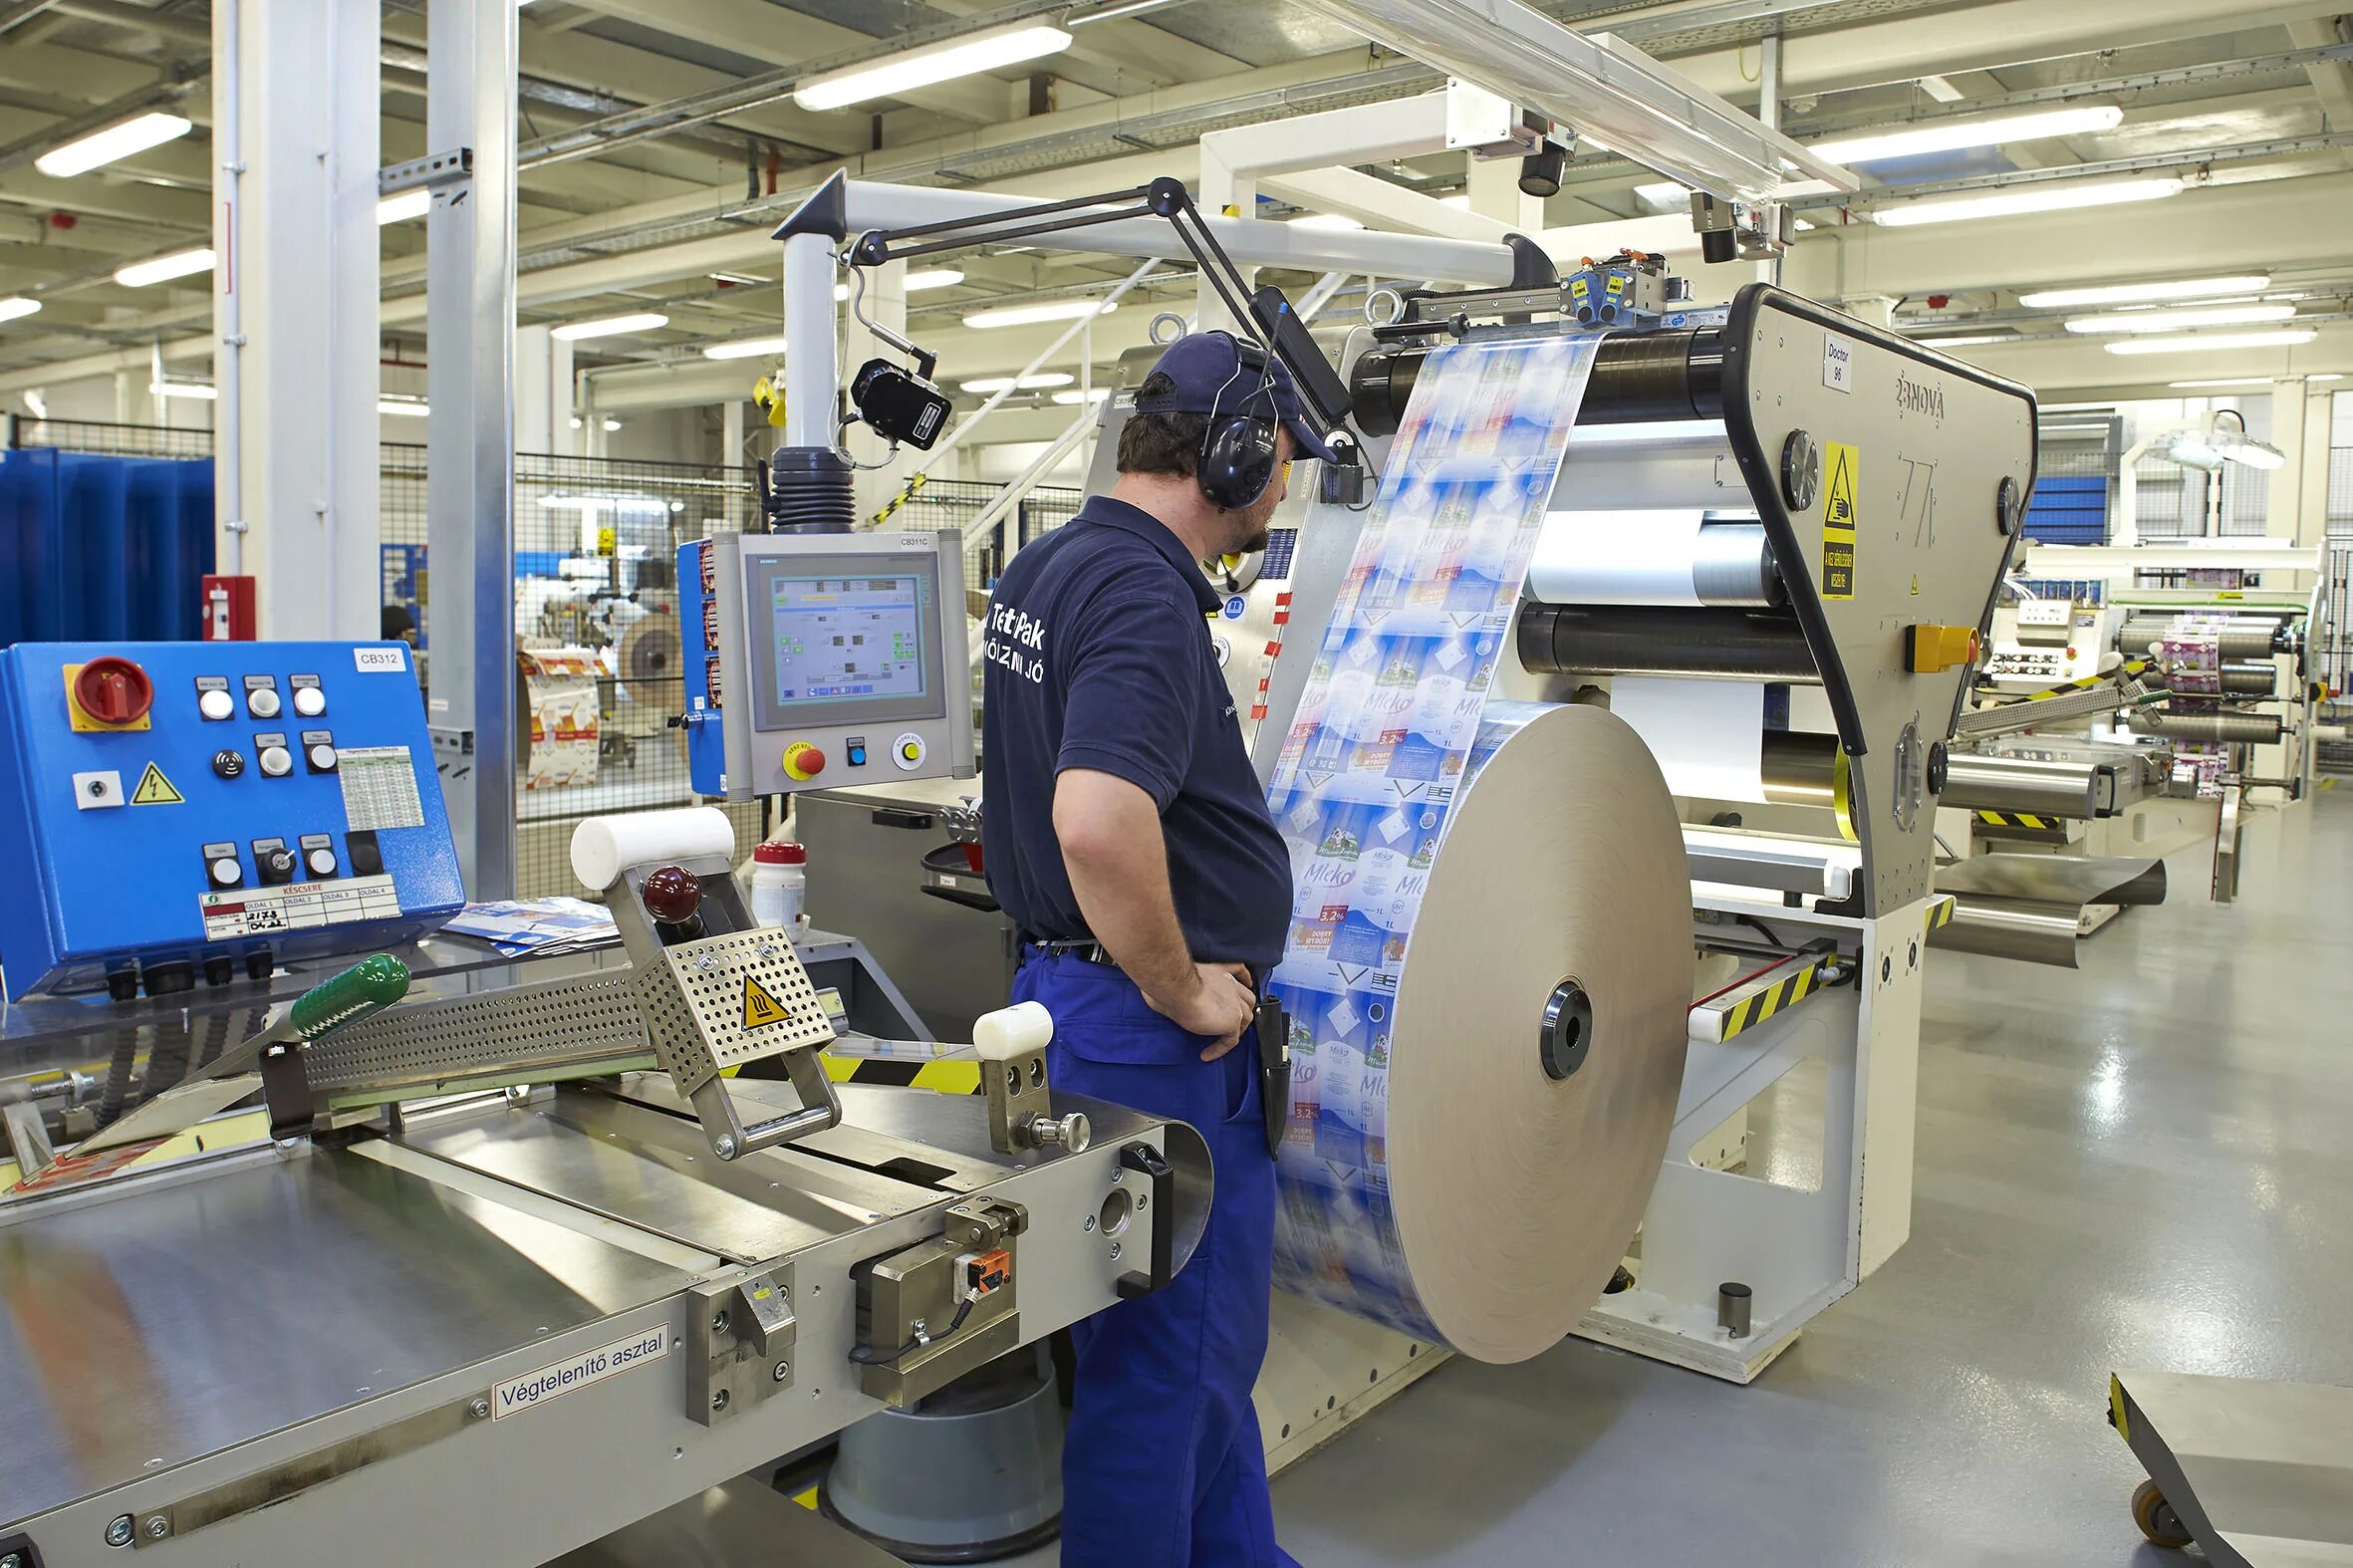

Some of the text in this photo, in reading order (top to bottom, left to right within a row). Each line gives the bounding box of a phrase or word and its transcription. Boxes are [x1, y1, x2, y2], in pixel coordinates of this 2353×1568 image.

[1829, 344, 1849, 363] Doctor
[1834, 367, 1842, 381] 96
[1013, 611, 1046, 651] Pak
[361, 653, 397, 664] CB312
[1025, 658, 1044, 683] JÓ
[1379, 734, 1404, 745] 3,2%
[1304, 863, 1357, 887] Mleko
[283, 884, 323, 896] KÉSCSERE
[245, 901, 270, 910] OLDAL
[1320, 911, 1345, 921] 3,2%
[1360, 1123, 1369, 1132] 1L
[501, 1333, 662, 1406] Végtelenítő asztal
